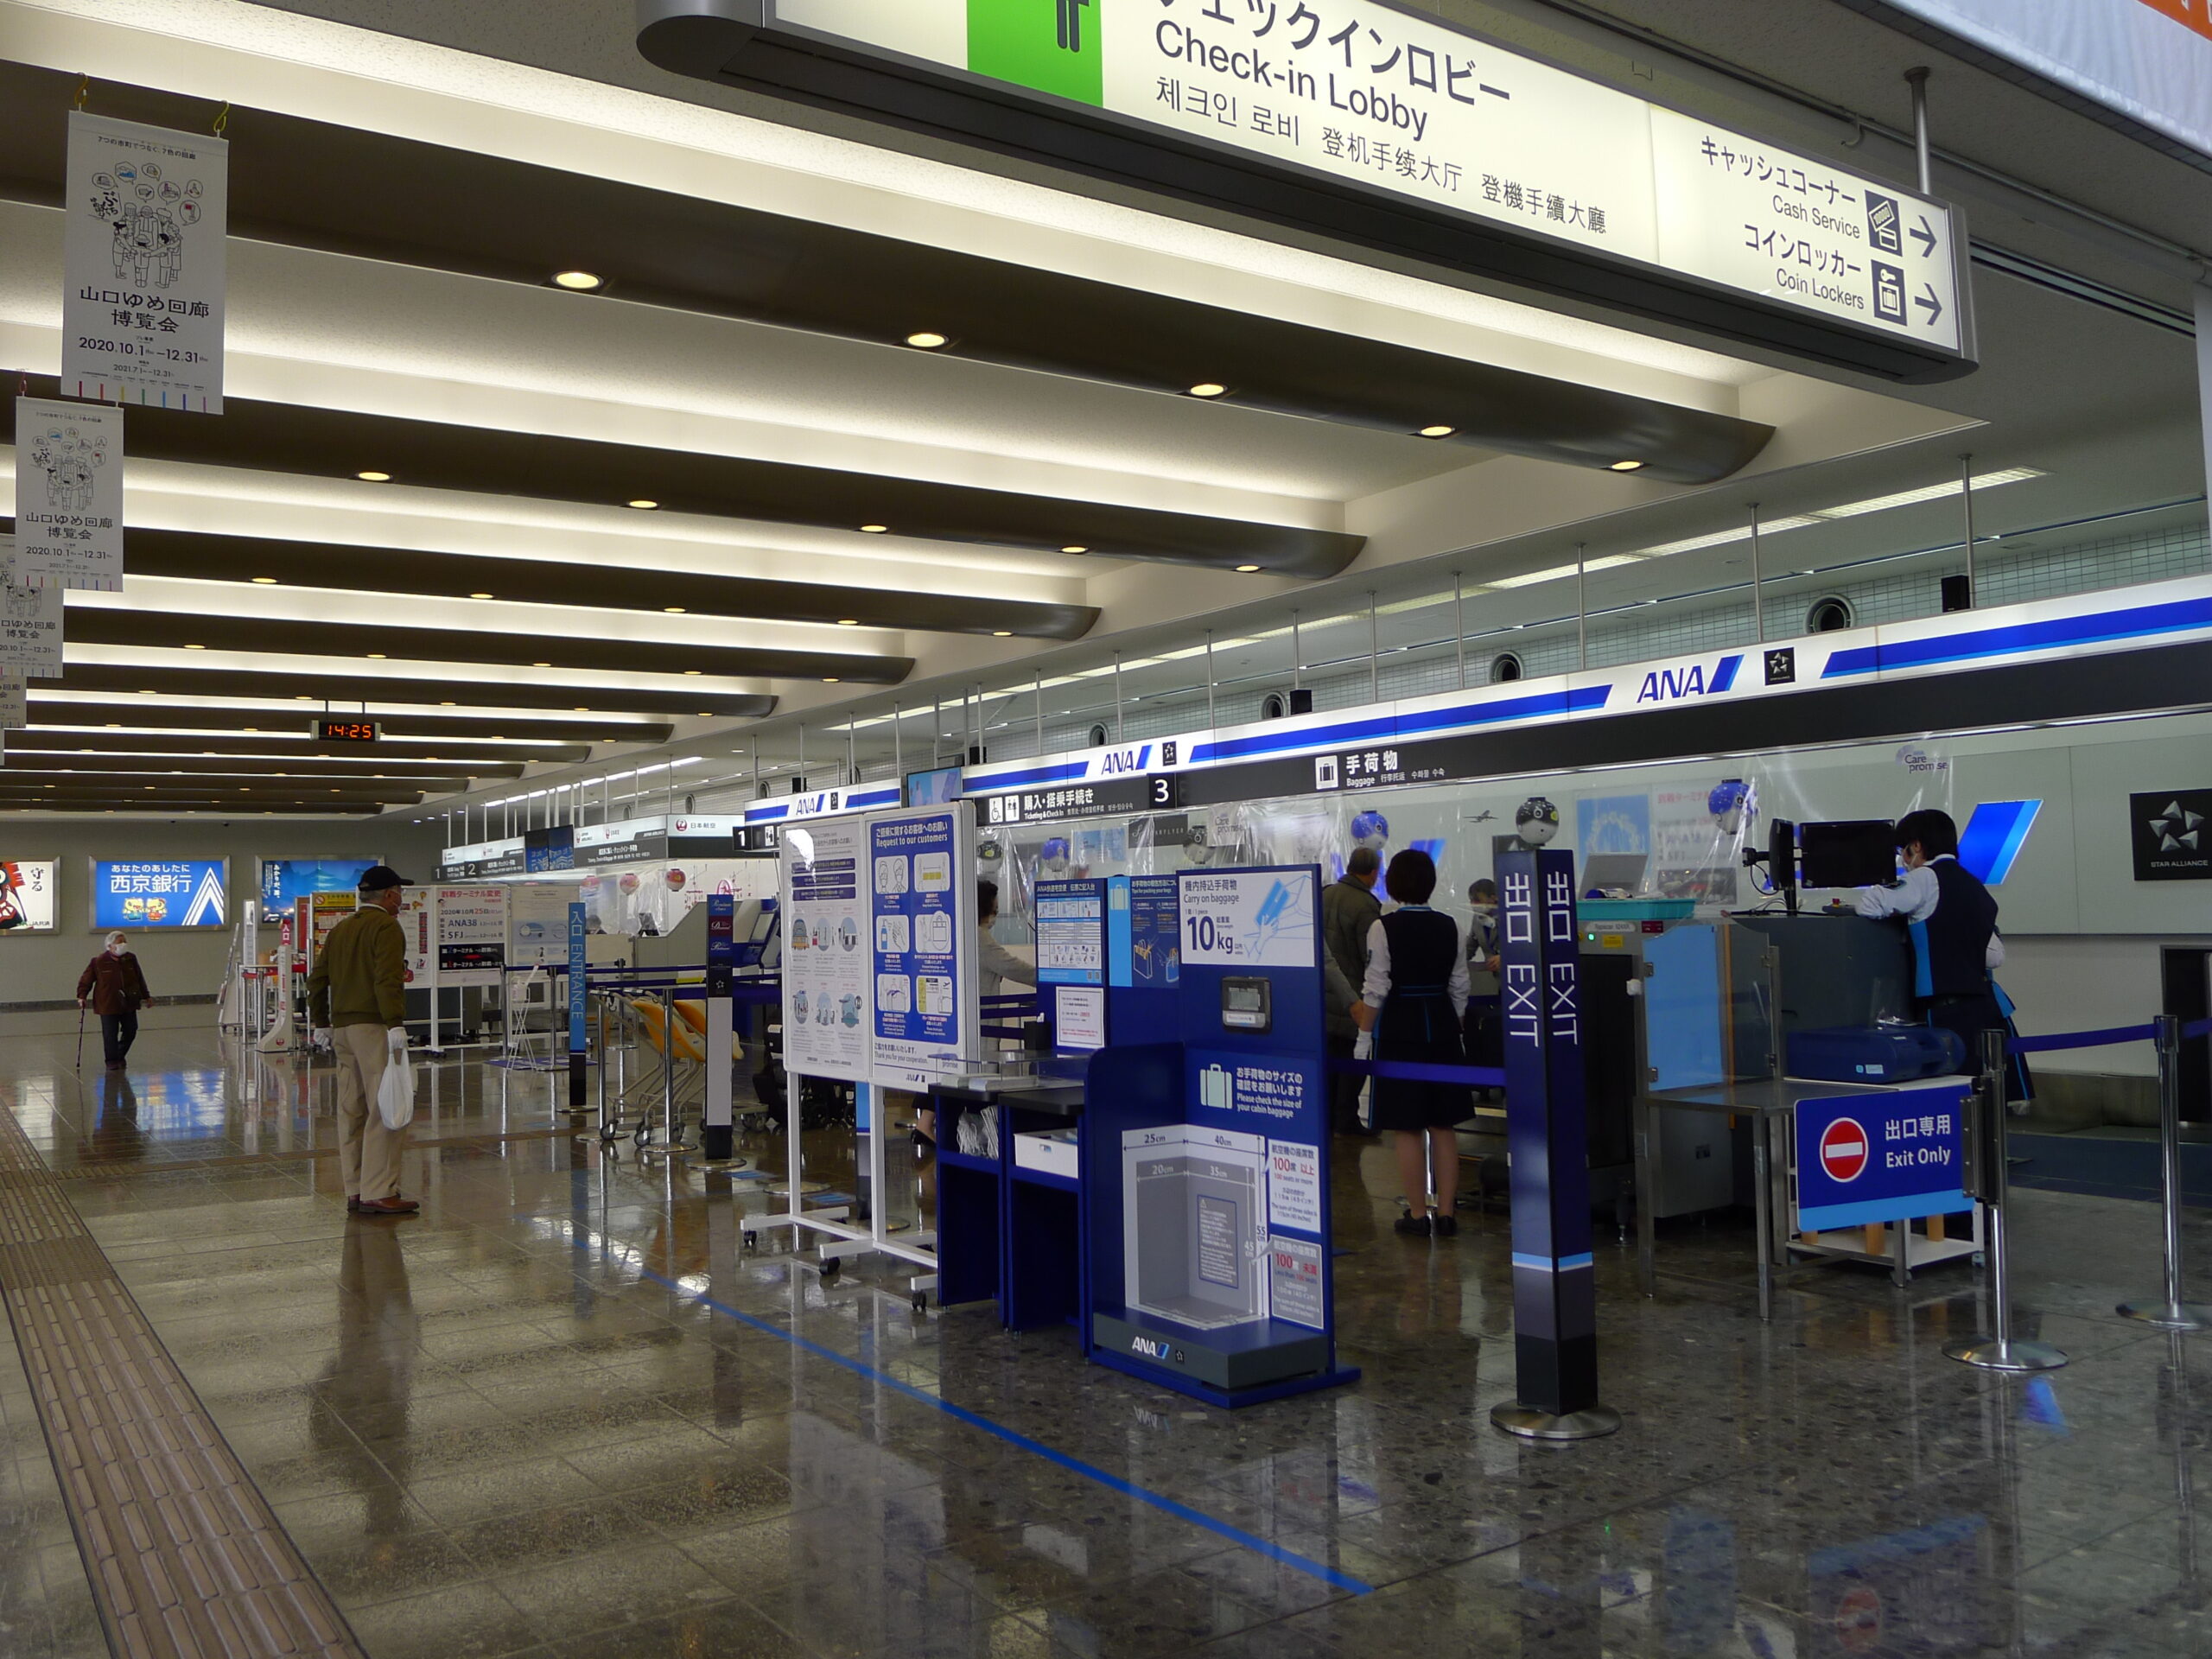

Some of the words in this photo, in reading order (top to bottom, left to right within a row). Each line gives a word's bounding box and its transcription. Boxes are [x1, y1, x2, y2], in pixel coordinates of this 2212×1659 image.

[1160, 0, 1510, 105] ェックインロビー
[1156, 21, 1316, 101] Check-in
[1330, 73, 1428, 142] Lobby
[1156, 75, 1237, 128] 체크인
[1250, 105, 1300, 146] 로비
[1321, 125, 1463, 193] 登机手续大厅
[1701, 136, 1857, 205] キャッシュコーナー
[1481, 174, 1607, 235] 登機手續大廳
[1773, 194, 1808, 223] Cash
[1812, 207, 1861, 239] Service
[1745, 224, 1861, 277] コインロッカー
[1777, 268, 1808, 295] Coin
[1813, 278, 1865, 310] Lockers
[80, 286, 210, 319] 山口ゆめ回廊
[111, 308, 180, 334] 博覧会
[26, 512, 113, 529] 山口ゆめ回廊
[46, 526, 93, 541] 博覧会
[1636, 665, 1706, 704] ANA
[328, 724, 372, 739] 14:25
[1101, 750, 1135, 776] ANA
[1346, 749, 1398, 775] 手荷物
[1904, 754, 1927, 765] Care
[1154, 779, 1169, 803] 3
[1346, 776, 1376, 788] Baggage
[795, 798, 816, 816] ANA
[1024, 788, 1094, 810] 購入・搭乗手続き
[739, 830, 746, 847] 1
[876, 838, 899, 848] Request
[899, 837, 906, 846] to
[906, 836, 916, 844] our
[918, 834, 948, 844] customers
[111, 864, 191, 873] あなたのあしたに
[435, 868, 440, 879] 1
[468, 863, 476, 875] 2
[30, 867, 45, 892] 守る
[110, 874, 192, 893] 西京銀行
[1185, 879, 1237, 892] 機内持込手荷物
[1184, 893, 1200, 905] Carry
[1211, 893, 1240, 905] baggage
[1505, 872, 1532, 944] 出口
[1548, 871, 1572, 943] 出口
[283, 924, 290, 941] 入口
[448, 918, 478, 927] ANA38
[571, 911, 583, 937] 入口
[1187, 916, 1215, 951] 10
[1217, 931, 1234, 955] kg
[571, 944, 583, 1020] ENTRANCE
[1507, 964, 1539, 1048] EXIT
[1549, 963, 1578, 1046] EXIT
[1236, 1067, 1303, 1084] お手荷物のサイズの
[1236, 1078, 1303, 1097] 確認をお願いします
[1236, 1092, 1255, 1103] Please
[1255, 1095, 1272, 1106] check
[1272, 1096, 1282, 1107] the
[1283, 1098, 1294, 1109] size
[1295, 1099, 1302, 1109] of
[1236, 1103, 1250, 1113] your
[1250, 1104, 1267, 1114] cabin
[1267, 1106, 1294, 1120] baggage
[1885, 1114, 1951, 1141] 出口専用
[1144, 1134, 1166, 1143] 25cm
[1214, 1135, 1232, 1147] 40cm
[1885, 1150, 1915, 1168] Exit
[1917, 1145, 1951, 1166] Only
[1210, 1166, 1228, 1178] 35cm
[1300, 1163, 1314, 1176] 以上
[1257, 1225, 1266, 1236] 55
[1244, 1240, 1254, 1252] 45
[1132, 1336, 1156, 1357] ANA
